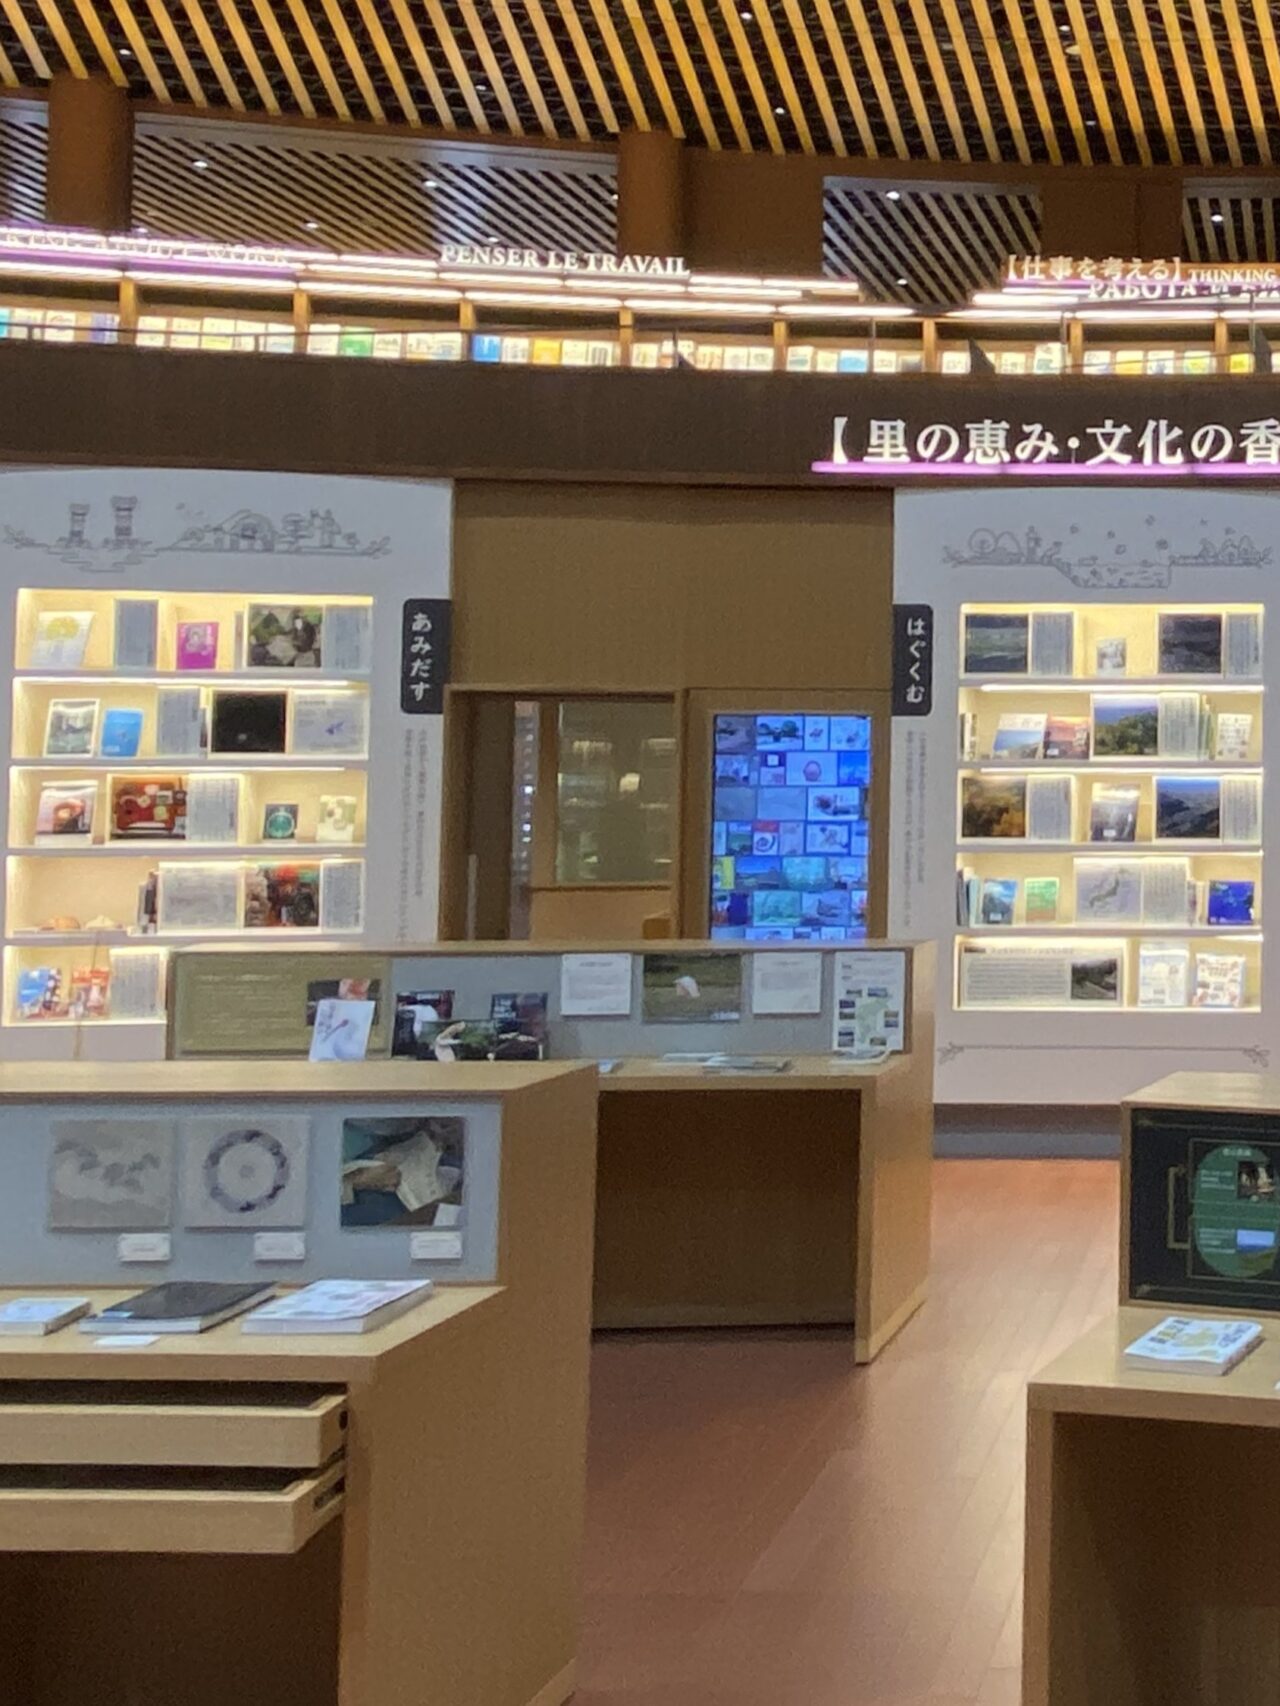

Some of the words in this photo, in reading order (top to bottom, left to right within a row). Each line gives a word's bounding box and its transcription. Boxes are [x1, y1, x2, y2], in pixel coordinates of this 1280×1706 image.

[440, 245, 541, 268] PENSER
[546, 251, 579, 271] LE
[583, 253, 691, 276] TRAVAIL
[1187, 267, 1277, 284] THINKING
[408, 612, 434, 702] あみだす
[905, 616, 927, 704] はぐくむ
